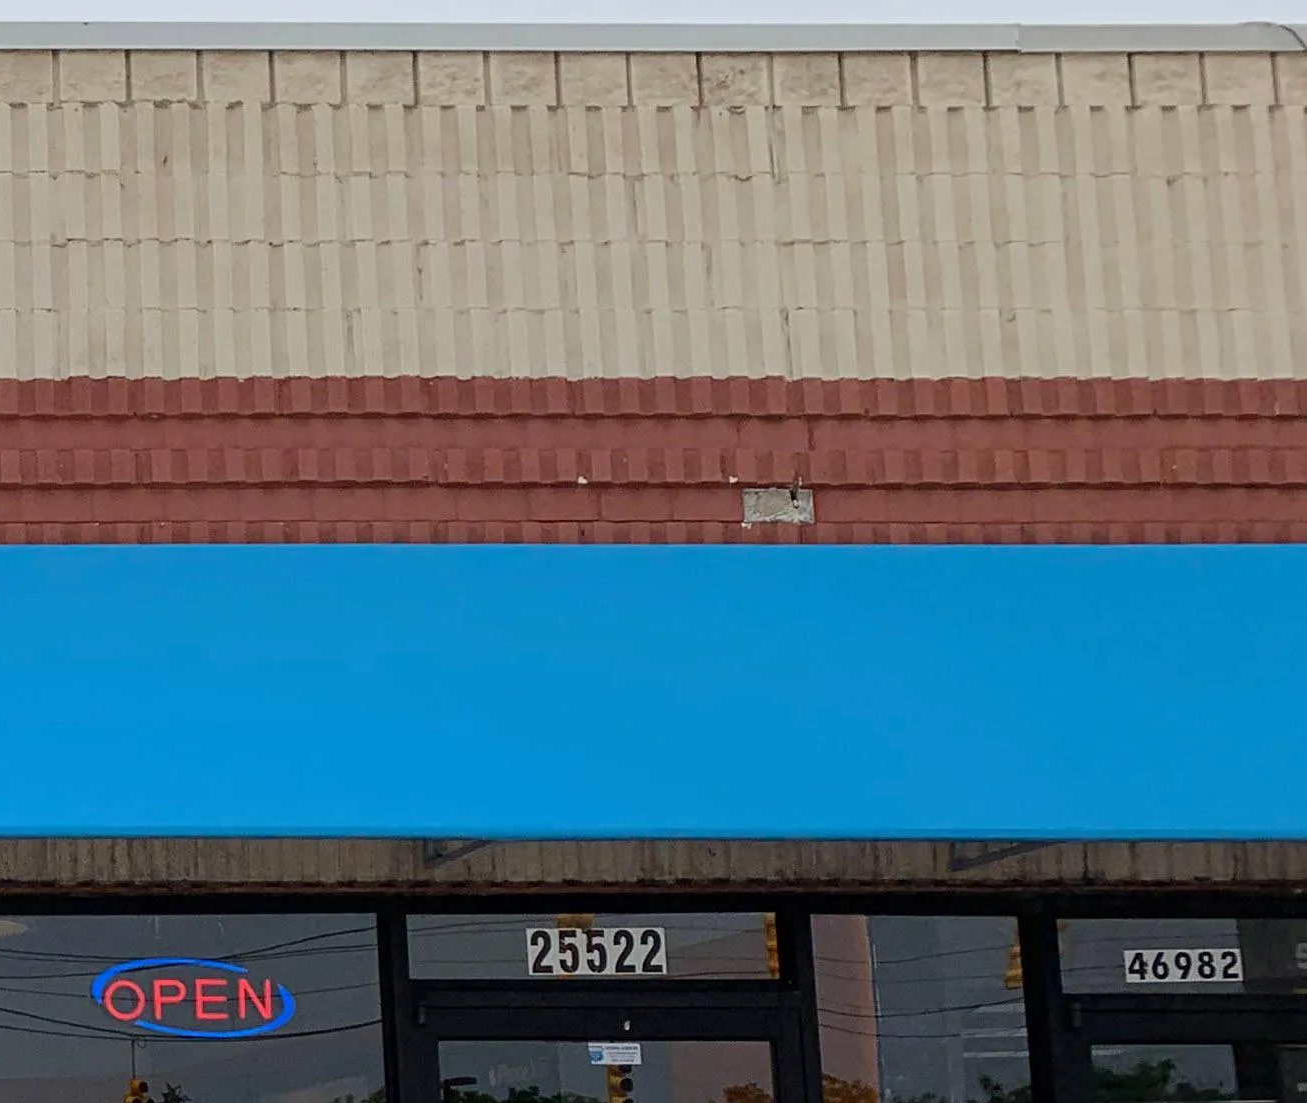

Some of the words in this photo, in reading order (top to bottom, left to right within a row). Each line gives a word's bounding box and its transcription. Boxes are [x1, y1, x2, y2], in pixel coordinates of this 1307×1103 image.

[529, 927, 666, 974] 25522
[1127, 950, 1240, 981] 46982
[103, 976, 274, 1022] OPEN
